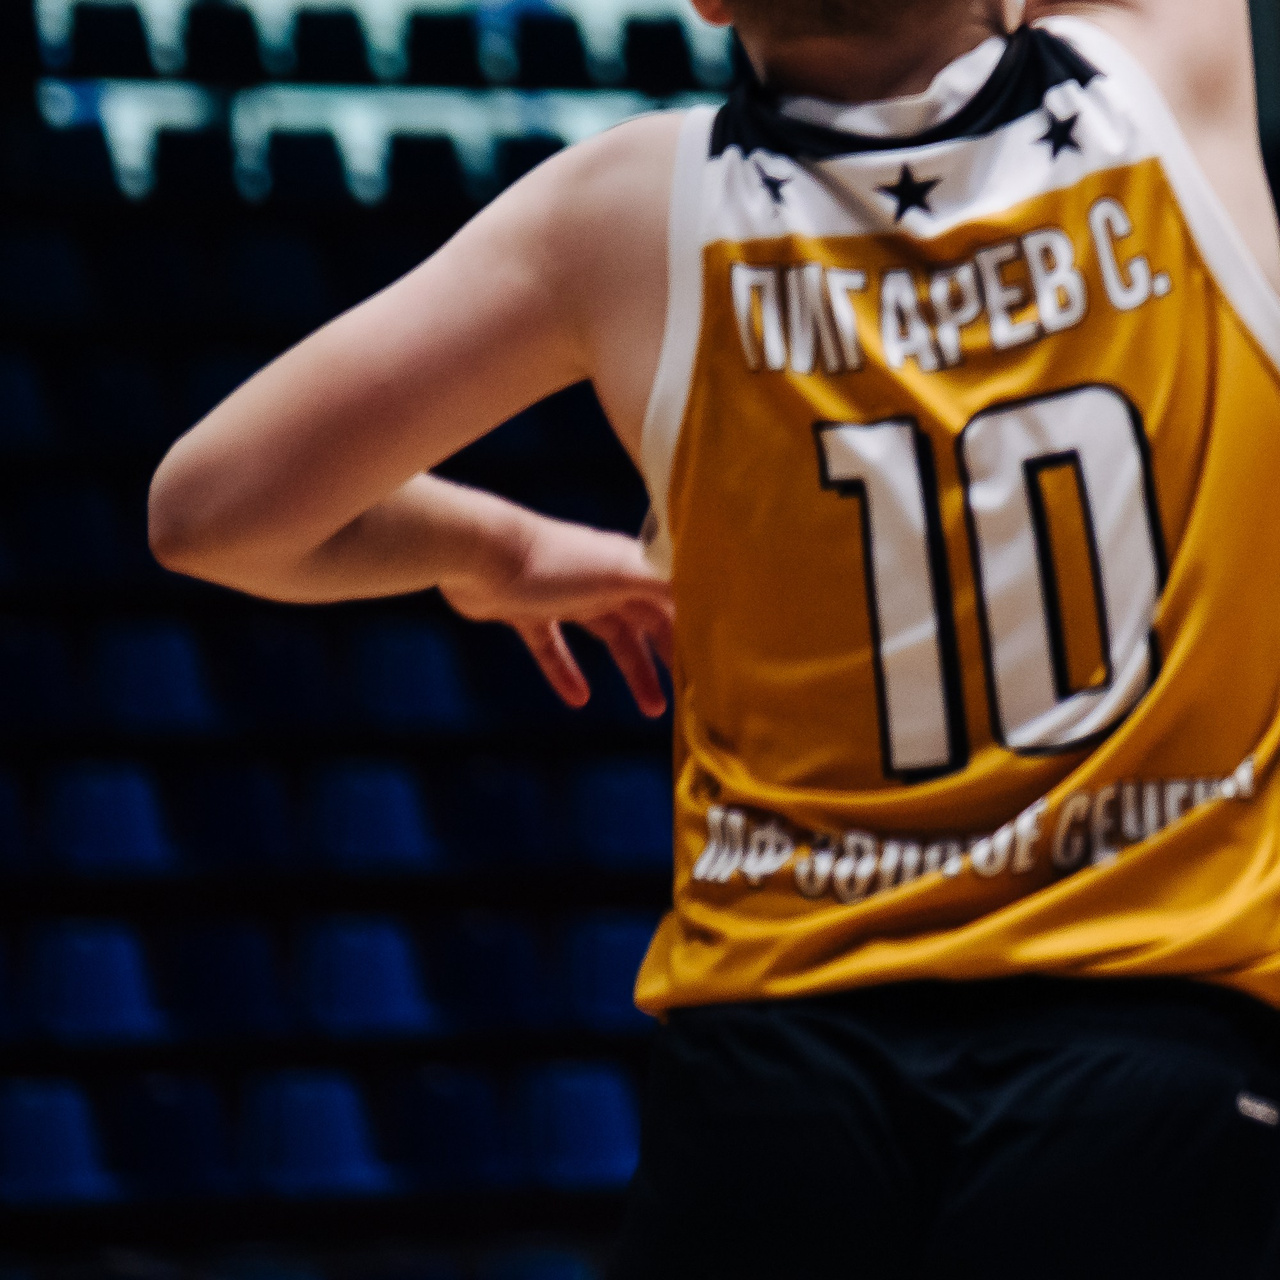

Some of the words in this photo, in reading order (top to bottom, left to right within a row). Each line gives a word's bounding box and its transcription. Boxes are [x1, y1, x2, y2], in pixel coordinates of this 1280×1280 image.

[731, 227, 1088, 373] ПИГАРЕВ
[1087, 197, 1172, 312] С.
[813, 382, 1166, 783] 10
